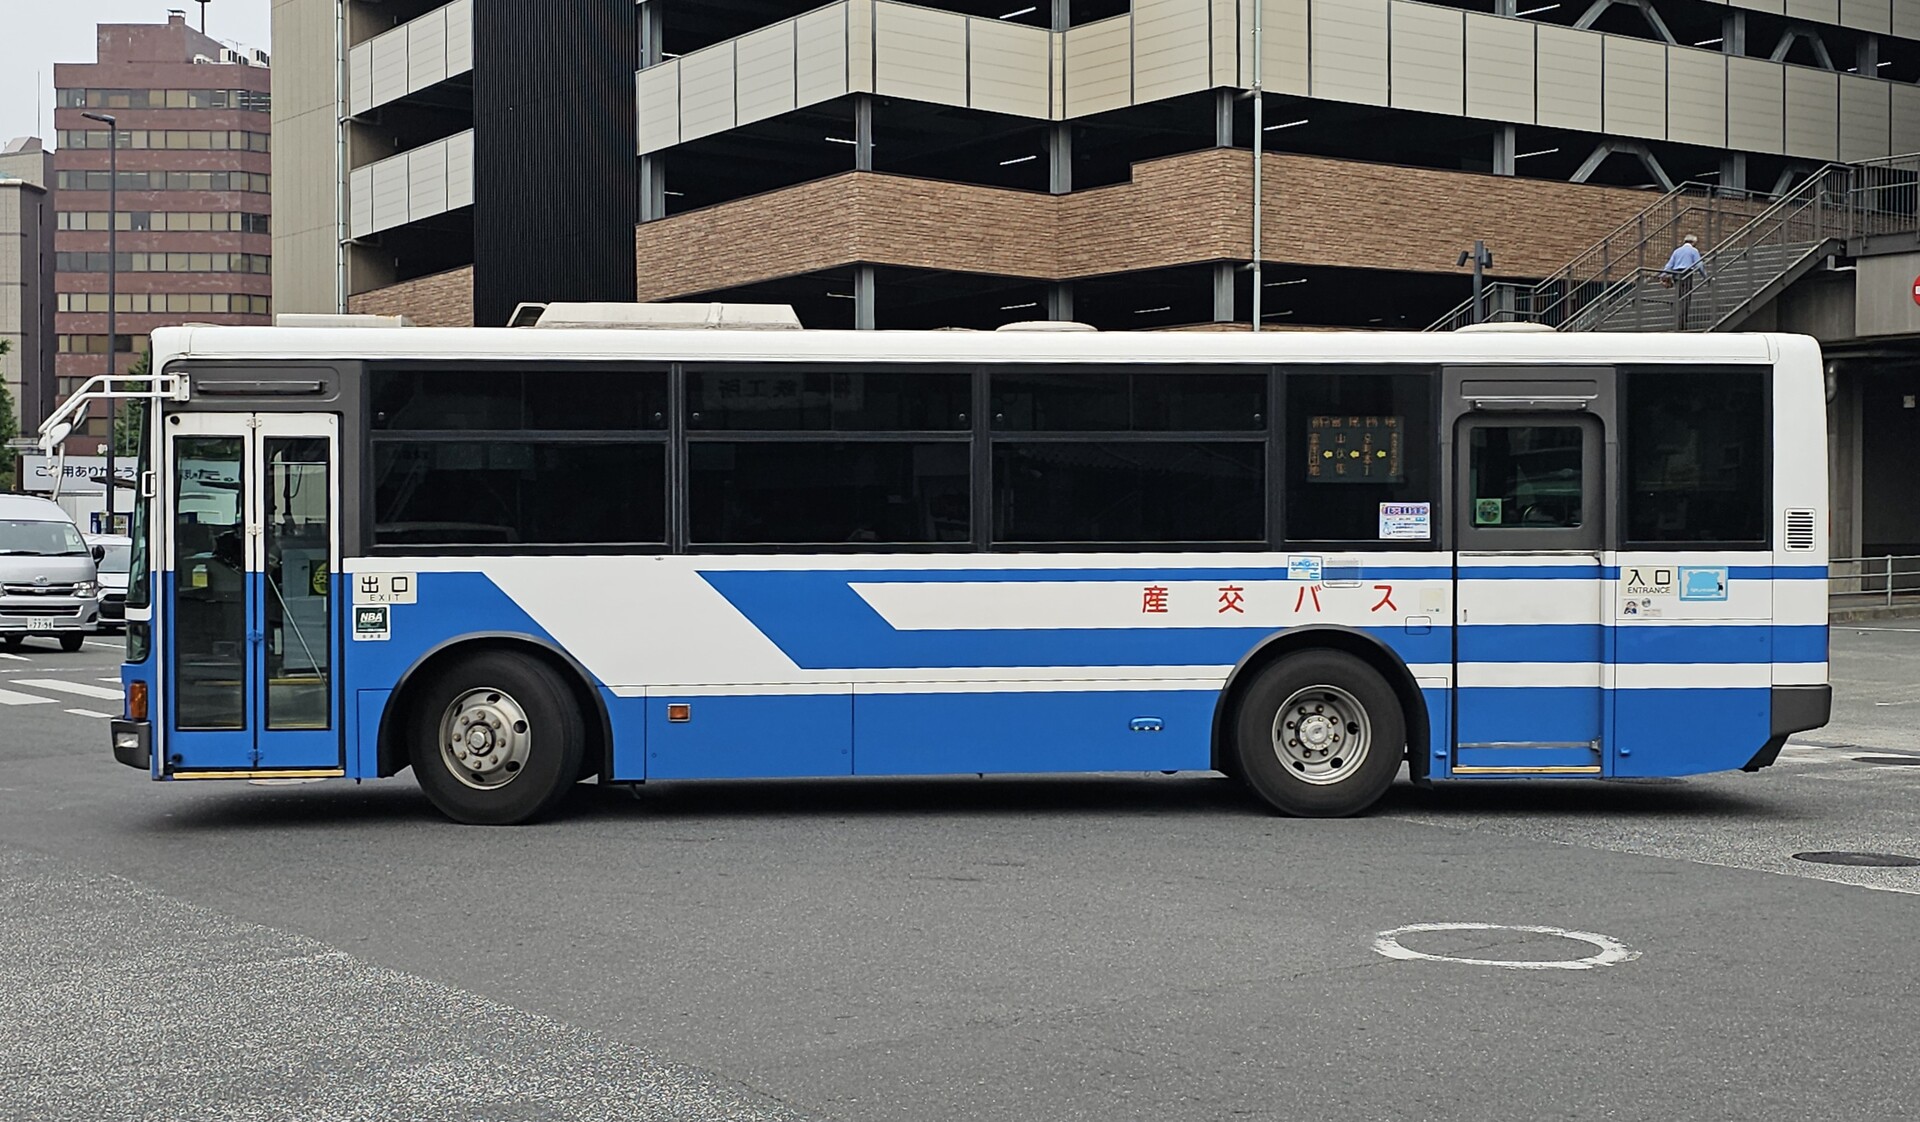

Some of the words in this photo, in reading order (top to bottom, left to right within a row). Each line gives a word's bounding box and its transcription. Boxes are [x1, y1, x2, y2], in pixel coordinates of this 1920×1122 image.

[361, 576, 408, 593] 出口
[1627, 569, 1671, 586] 入口
[1142, 584, 1398, 613] 産交バス
[1627, 586, 1671, 594] ENTRANCE
[360, 612, 383, 623] NBA
